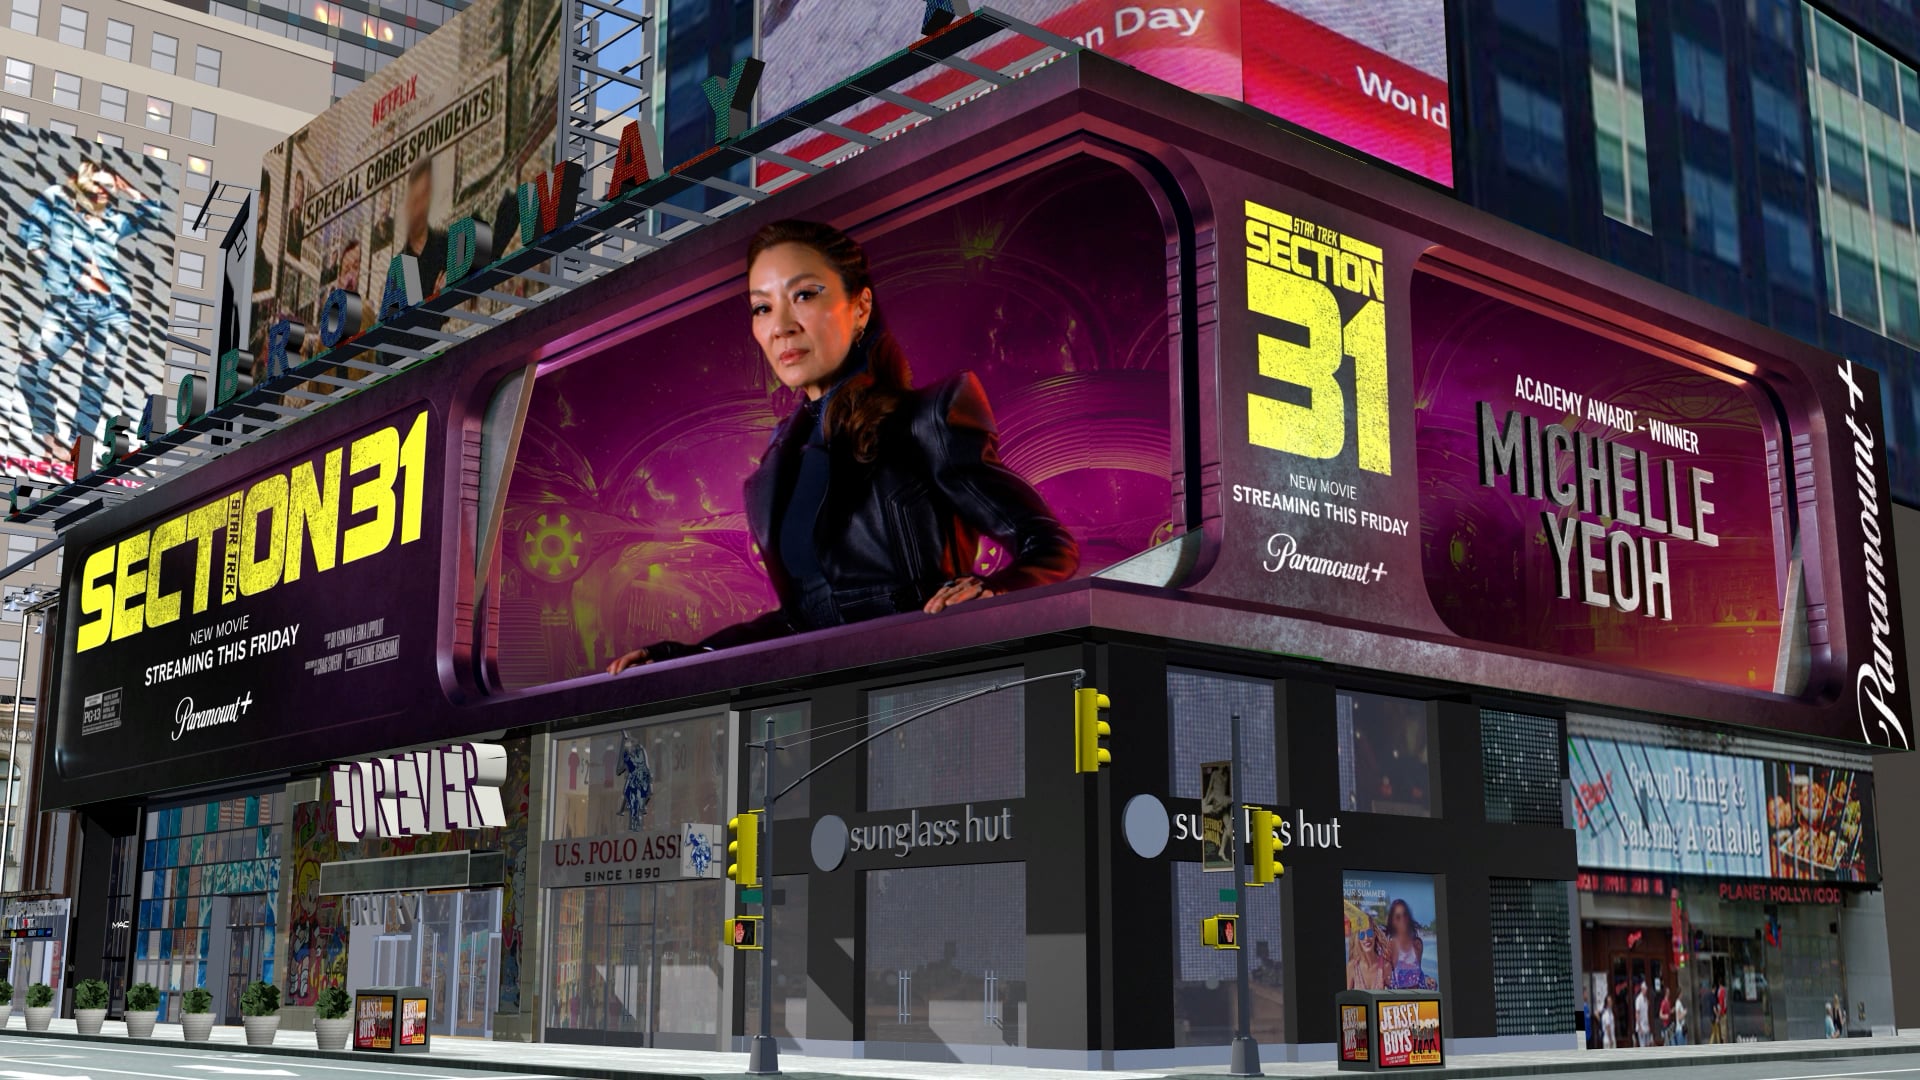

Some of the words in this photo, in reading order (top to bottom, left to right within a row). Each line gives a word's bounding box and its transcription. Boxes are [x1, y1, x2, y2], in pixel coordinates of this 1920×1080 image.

[1115, 7, 1204, 37] Day
[371, 74, 418, 128] NETFLIX
[1356, 65, 1447, 129] World
[304, 182, 362, 229] SPECIAL
[366, 88, 491, 192] CORRESPONDENTS
[218, 57, 764, 404] BROADWAY
[1294, 218, 1315, 239] STAR
[1317, 225, 1339, 247] TREK
[1245, 218, 1385, 303] SECTION
[1247, 259, 1392, 476] 31
[1515, 374, 1582, 416] ACADEMY
[1649, 418, 1700, 455] WINNER
[1290, 473, 1317, 491] NEW
[1320, 479, 1357, 500] MOVIE
[1476, 400, 1719, 547] MICHELLE
[229, 500, 240, 544] STAR
[1233, 485, 1320, 517] STREAMING
[1324, 503, 1356, 525] THIS
[1361, 511, 1409, 536] FRIDAY
[224, 551, 237, 596] TREK
[1263, 533, 1388, 585] Paramount+
[1541, 512, 1672, 621] YEOH
[1838, 360, 1909, 751] Paramount+
[189, 626, 213, 646] NEW
[215, 614, 250, 638] MOVIE
[144, 649, 213, 686] STREAMING
[218, 640, 246, 666] THIS
[250, 623, 300, 657] FRIDAY
[83, 707, 101, 724] PG-13
[171, 691, 253, 741] Paramount+
[330, 742, 501, 842] FOREVER
[1674, 766, 1728, 813] Dining
[1732, 774, 1747, 808] &
[555, 842, 584, 867] U.S.
[589, 838, 638, 864] POLO
[642, 834, 681, 861] ASS
[851, 808, 960, 857] sunglass
[965, 803, 1015, 843] hut
[1296, 808, 1342, 849] hut
[1687, 816, 1762, 857] Available
[585, 869, 622, 882] SINCE
[629, 867, 661, 879] 1890
[1358, 889, 1386, 898] SUMMER
[1719, 883, 1767, 901] PLANET
[1769, 885, 1841, 904] HOLLYWOOD
[1381, 1003, 1419, 1030] JERSEY
[1383, 1028, 1413, 1056] BOYS
